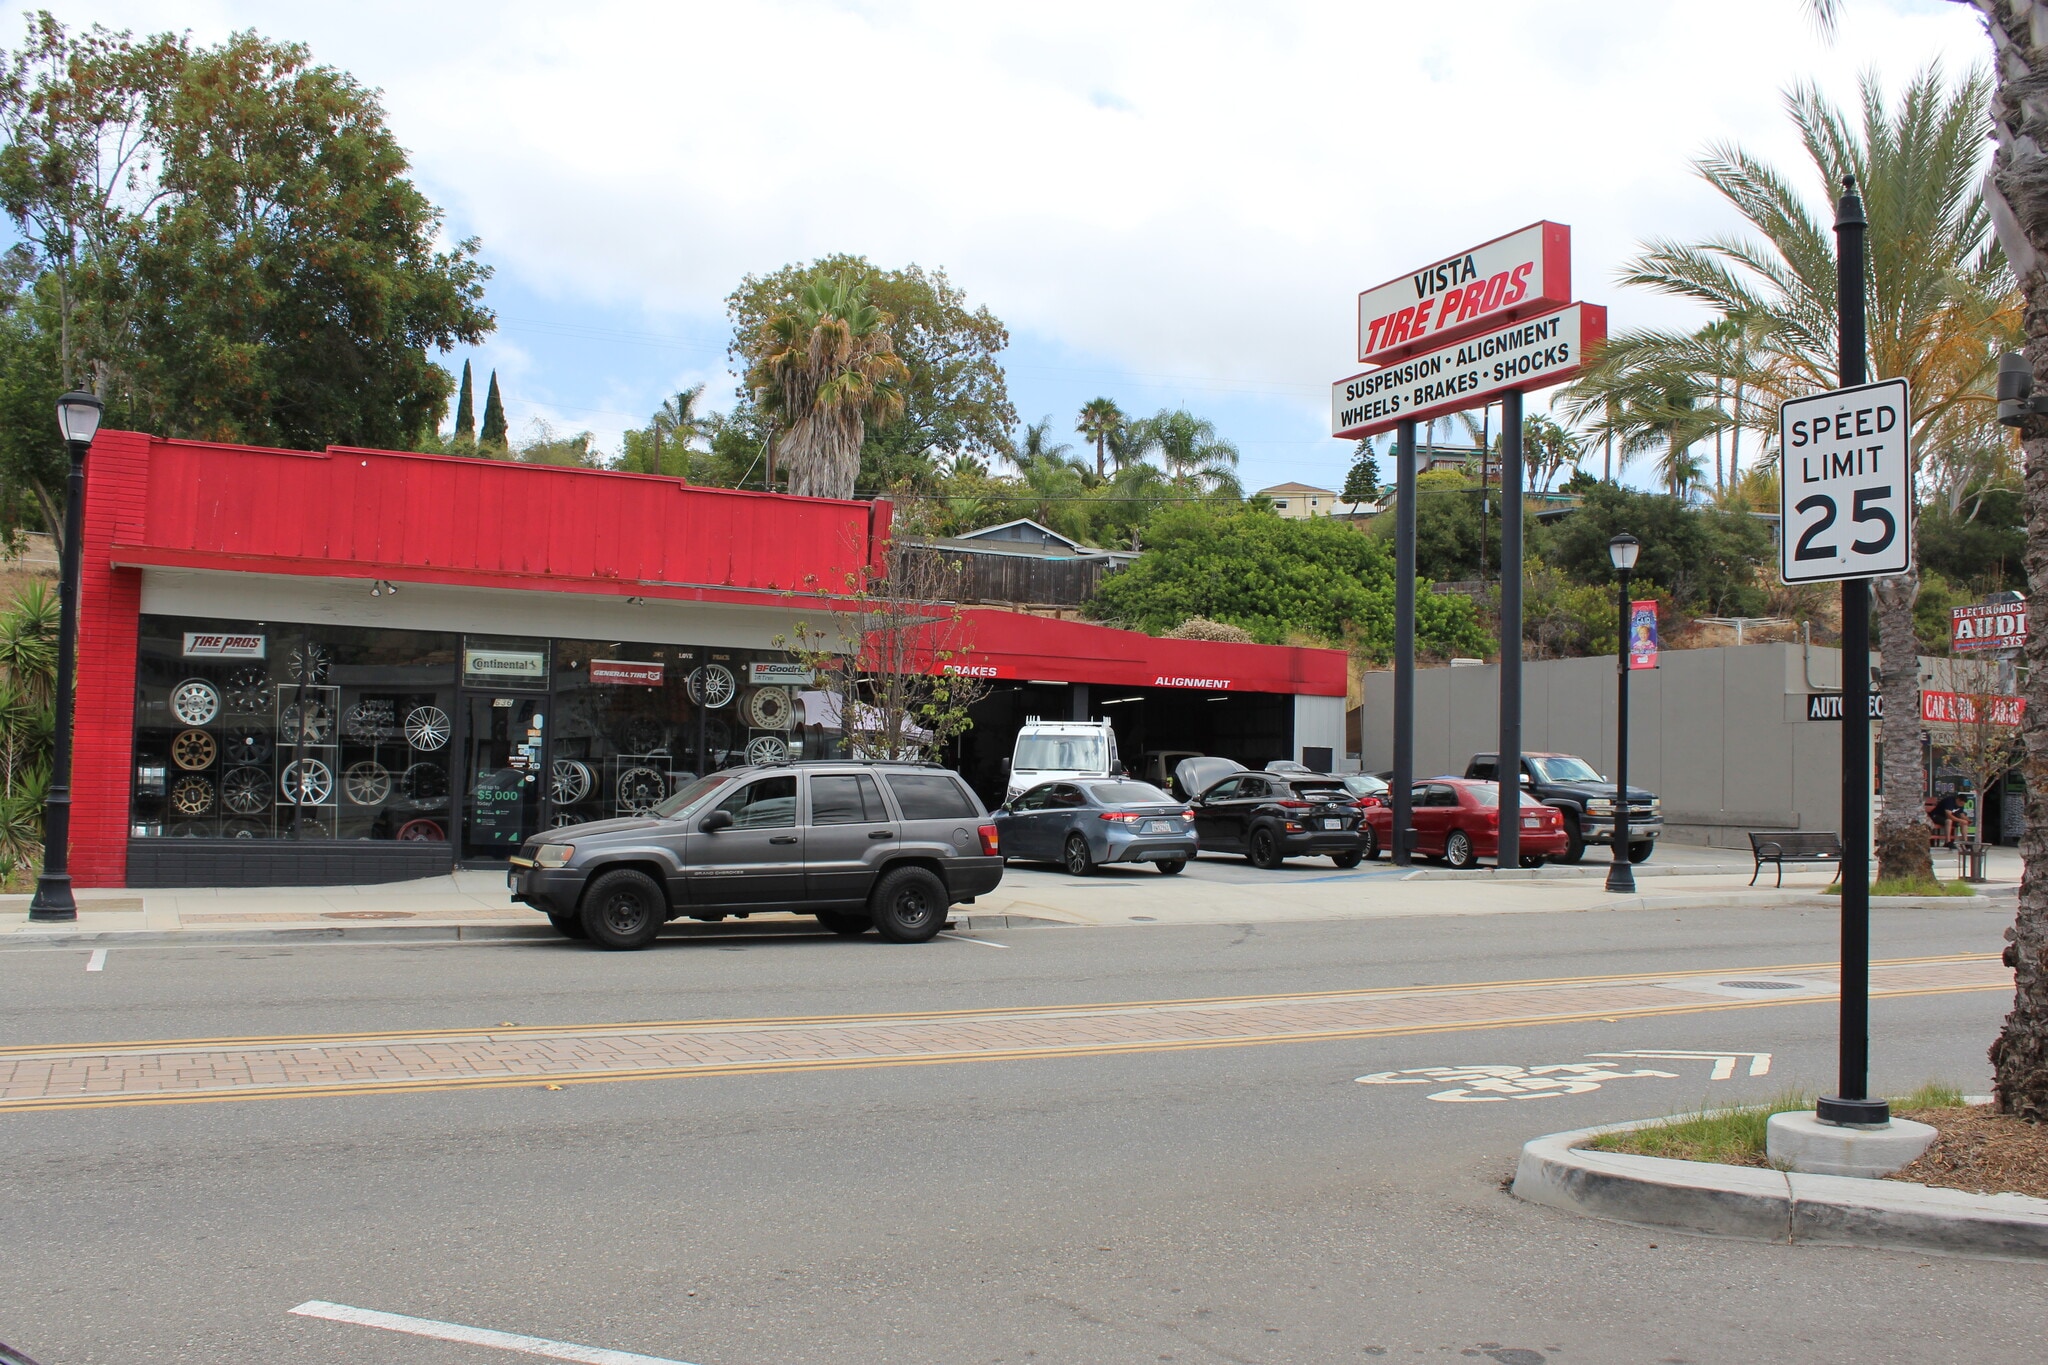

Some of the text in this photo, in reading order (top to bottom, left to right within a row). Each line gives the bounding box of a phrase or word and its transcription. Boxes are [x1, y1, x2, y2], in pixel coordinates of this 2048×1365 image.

[1414, 254, 1477, 299] VISTA
[1364, 261, 1534, 355] TIRE PROS
[1346, 317, 1560, 402] SUSPENSION ALIGNMENT
[1340, 342, 1569, 428] WHEELS BRAKES SHOCKS
[1791, 404, 1896, 448] SPEED
[1803, 444, 1884, 484] LIMIT
[1794, 485, 1896, 562] 25
[1953, 602, 2024, 619] ELECTRONICS
[190, 636, 261, 654] TIRE PROS
[472, 658, 528, 671] Continental
[593, 669, 629, 678] GENERAL
[755, 664, 811, 673] BFGoodri
[1155, 676, 1231, 689] ALIGNMENT
[494, 699, 513, 707] 636
[1925, 694, 1945, 720] CAR
[477, 790, 518, 802] $5,000
